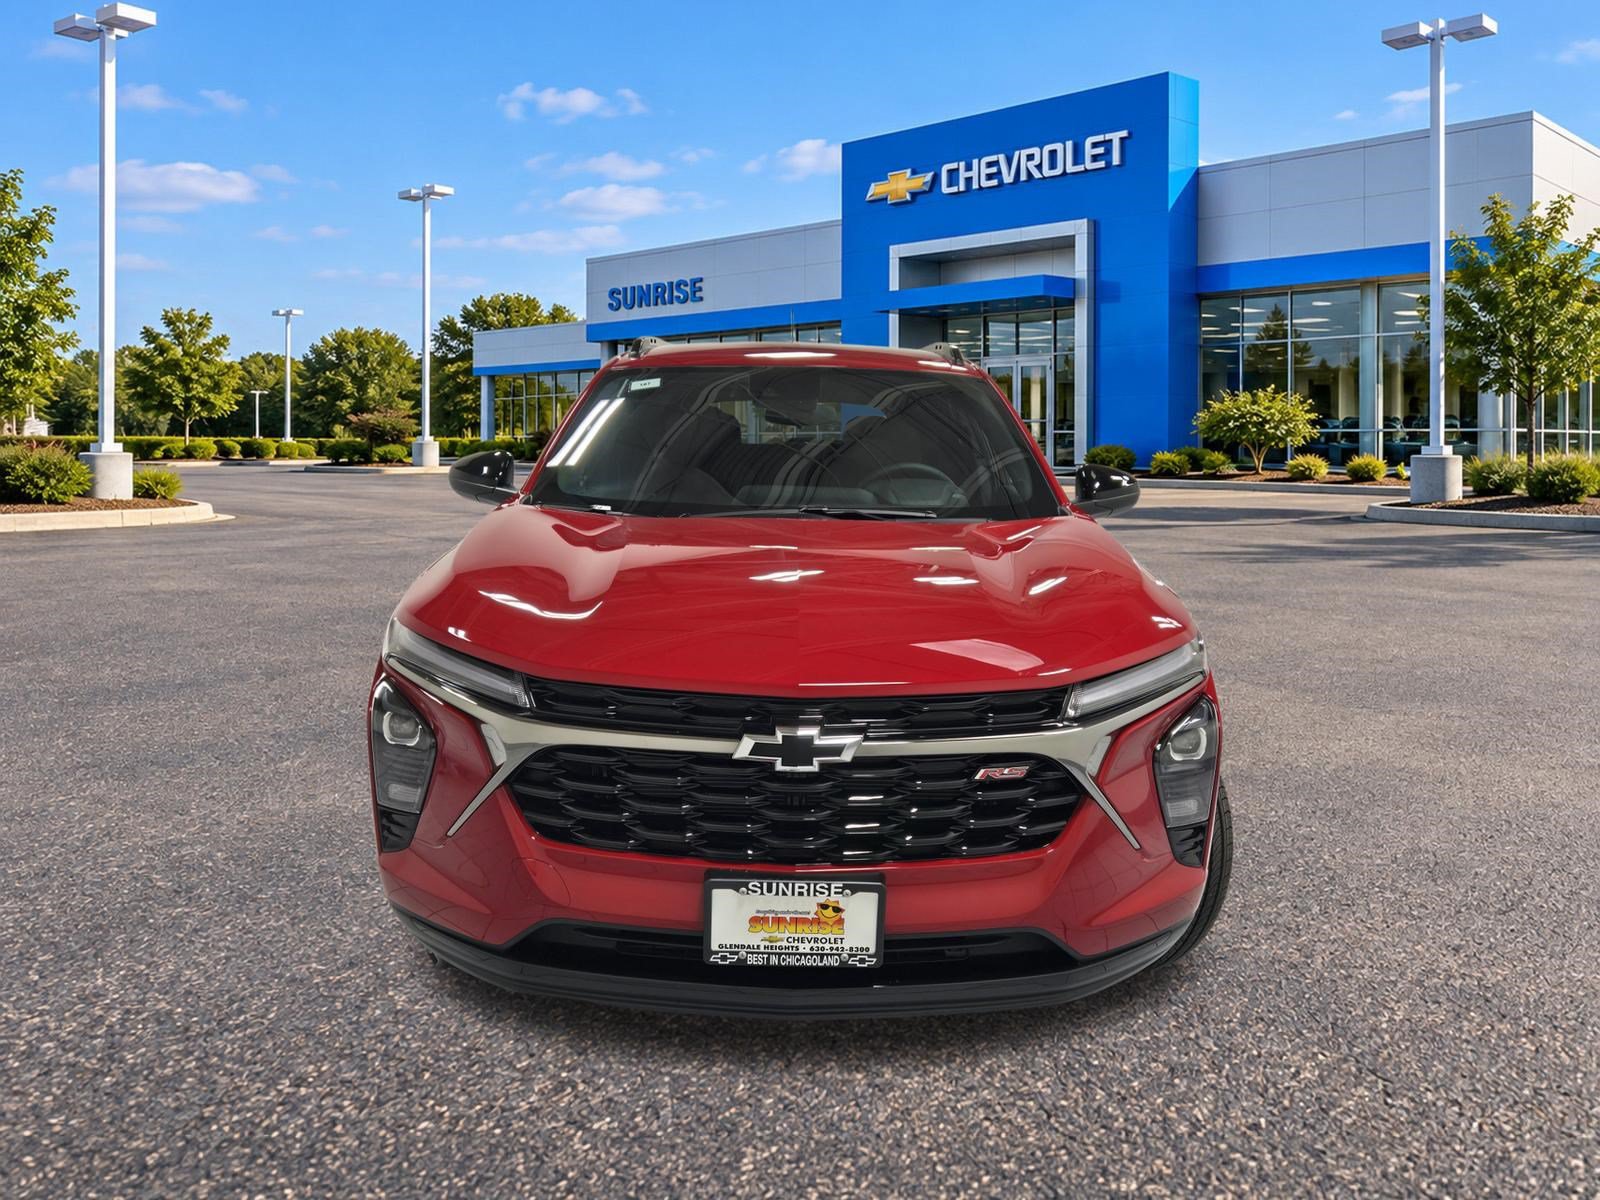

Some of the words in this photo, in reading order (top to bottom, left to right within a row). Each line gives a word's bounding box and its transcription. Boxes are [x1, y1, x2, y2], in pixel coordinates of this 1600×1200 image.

[941, 130, 1129, 194] CHEVROLET
[608, 277, 704, 311] SUNRISE
[974, 766, 1030, 780] RS
[748, 881, 843, 897] SUNRISE
[748, 915, 845, 935] SUNRISE
[718, 943, 761, 951] GLENDALE
[763, 944, 800, 952] HEIGHTS
[809, 945, 870, 953] 630-942-8300
[786, 936, 845, 945] CHEVROLET
[746, 953, 769, 965] BEST
[770, 954, 778, 965] IN
[780, 955, 840, 966] CHICAGOLAND
